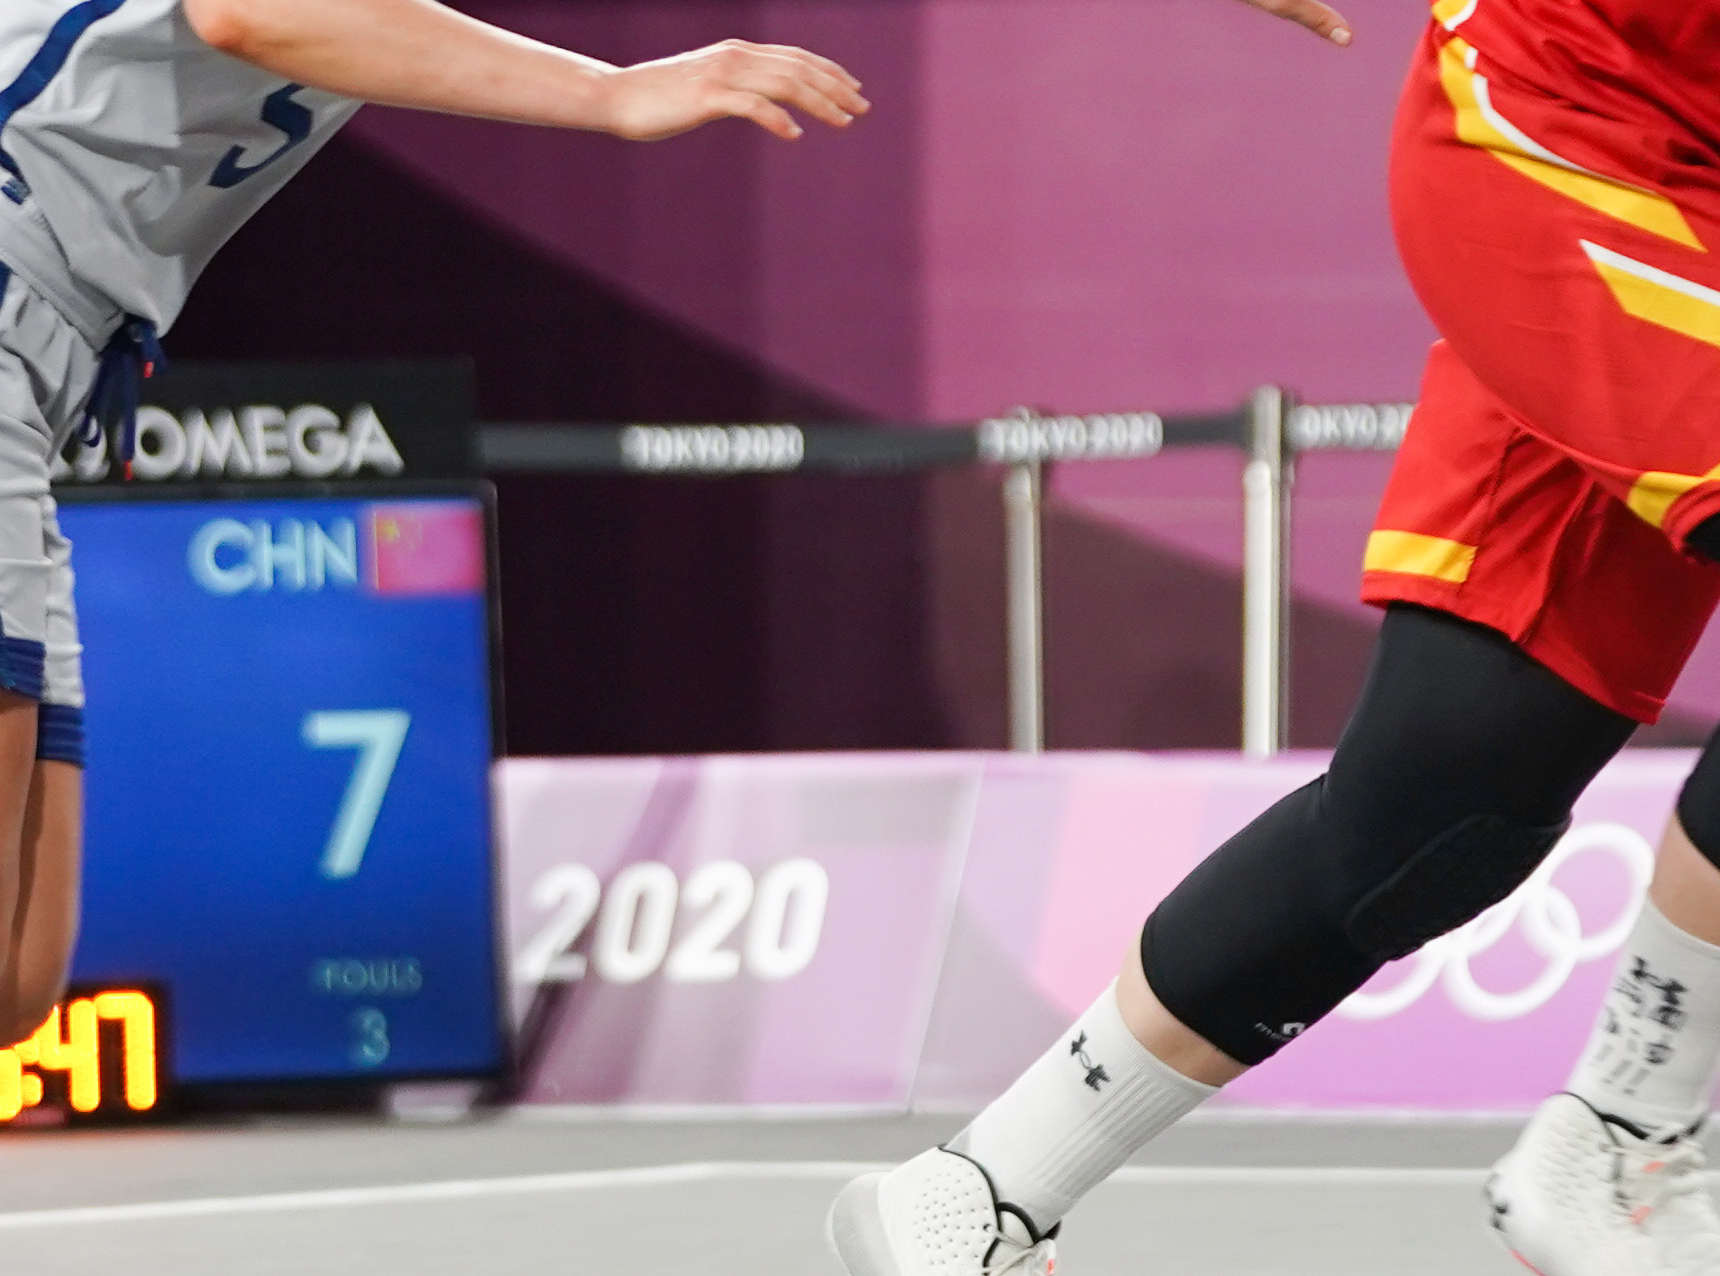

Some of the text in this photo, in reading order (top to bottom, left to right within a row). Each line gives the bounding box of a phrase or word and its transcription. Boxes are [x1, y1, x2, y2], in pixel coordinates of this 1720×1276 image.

[118, 402, 405, 482] OMEGA
[621, 424, 804, 471] TOKYO 2020
[978, 411, 1163, 463] TOKYO 2020
[1285, 404, 1379, 449] OKYO
[188, 517, 359, 597] CHN
[299, 708, 412, 880] 7
[515, 857, 829, 986] 2020
